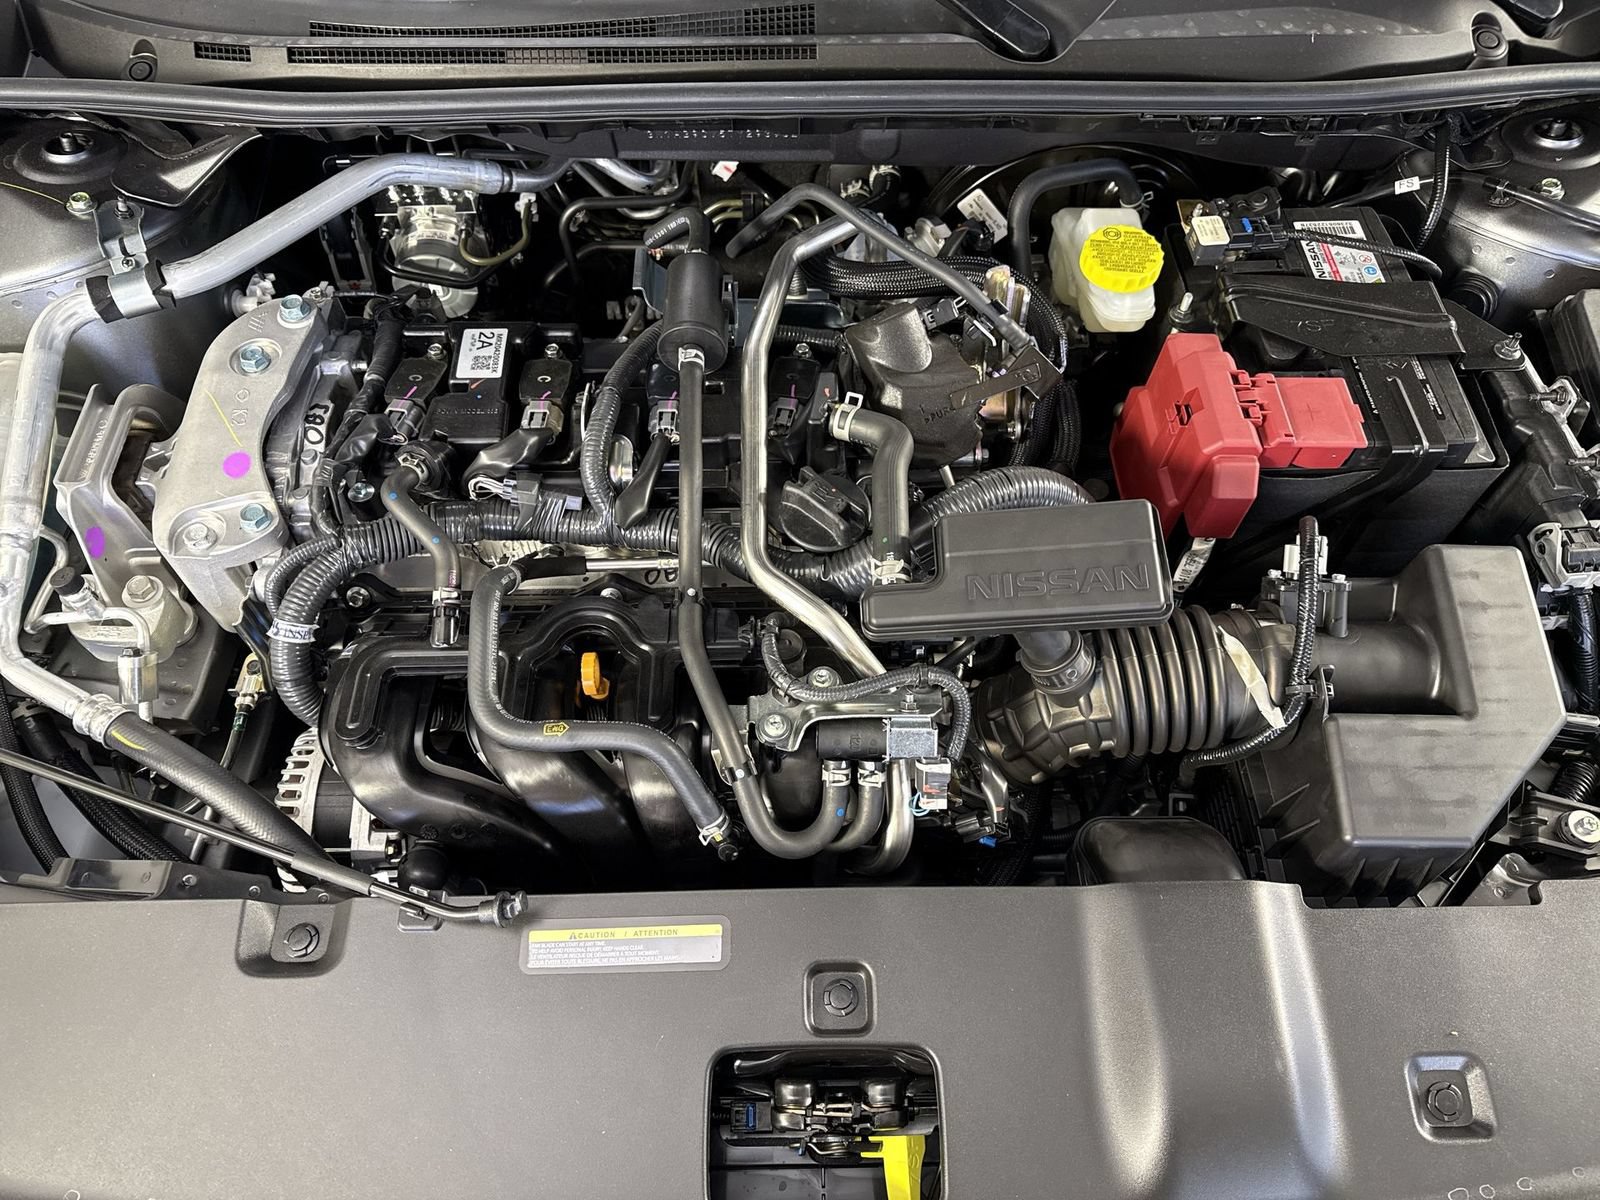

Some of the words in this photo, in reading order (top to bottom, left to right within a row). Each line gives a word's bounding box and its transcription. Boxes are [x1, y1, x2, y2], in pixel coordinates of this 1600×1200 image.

[1399, 179, 1415, 189] FS
[1305, 240, 1328, 279] NISSAN
[476, 331, 495, 350] 2A
[966, 563, 1150, 600] NISSAN
[547, 724, 564, 732] ENG
[578, 931, 616, 939] CAUTION
[633, 928, 679, 937] ATTENTION
